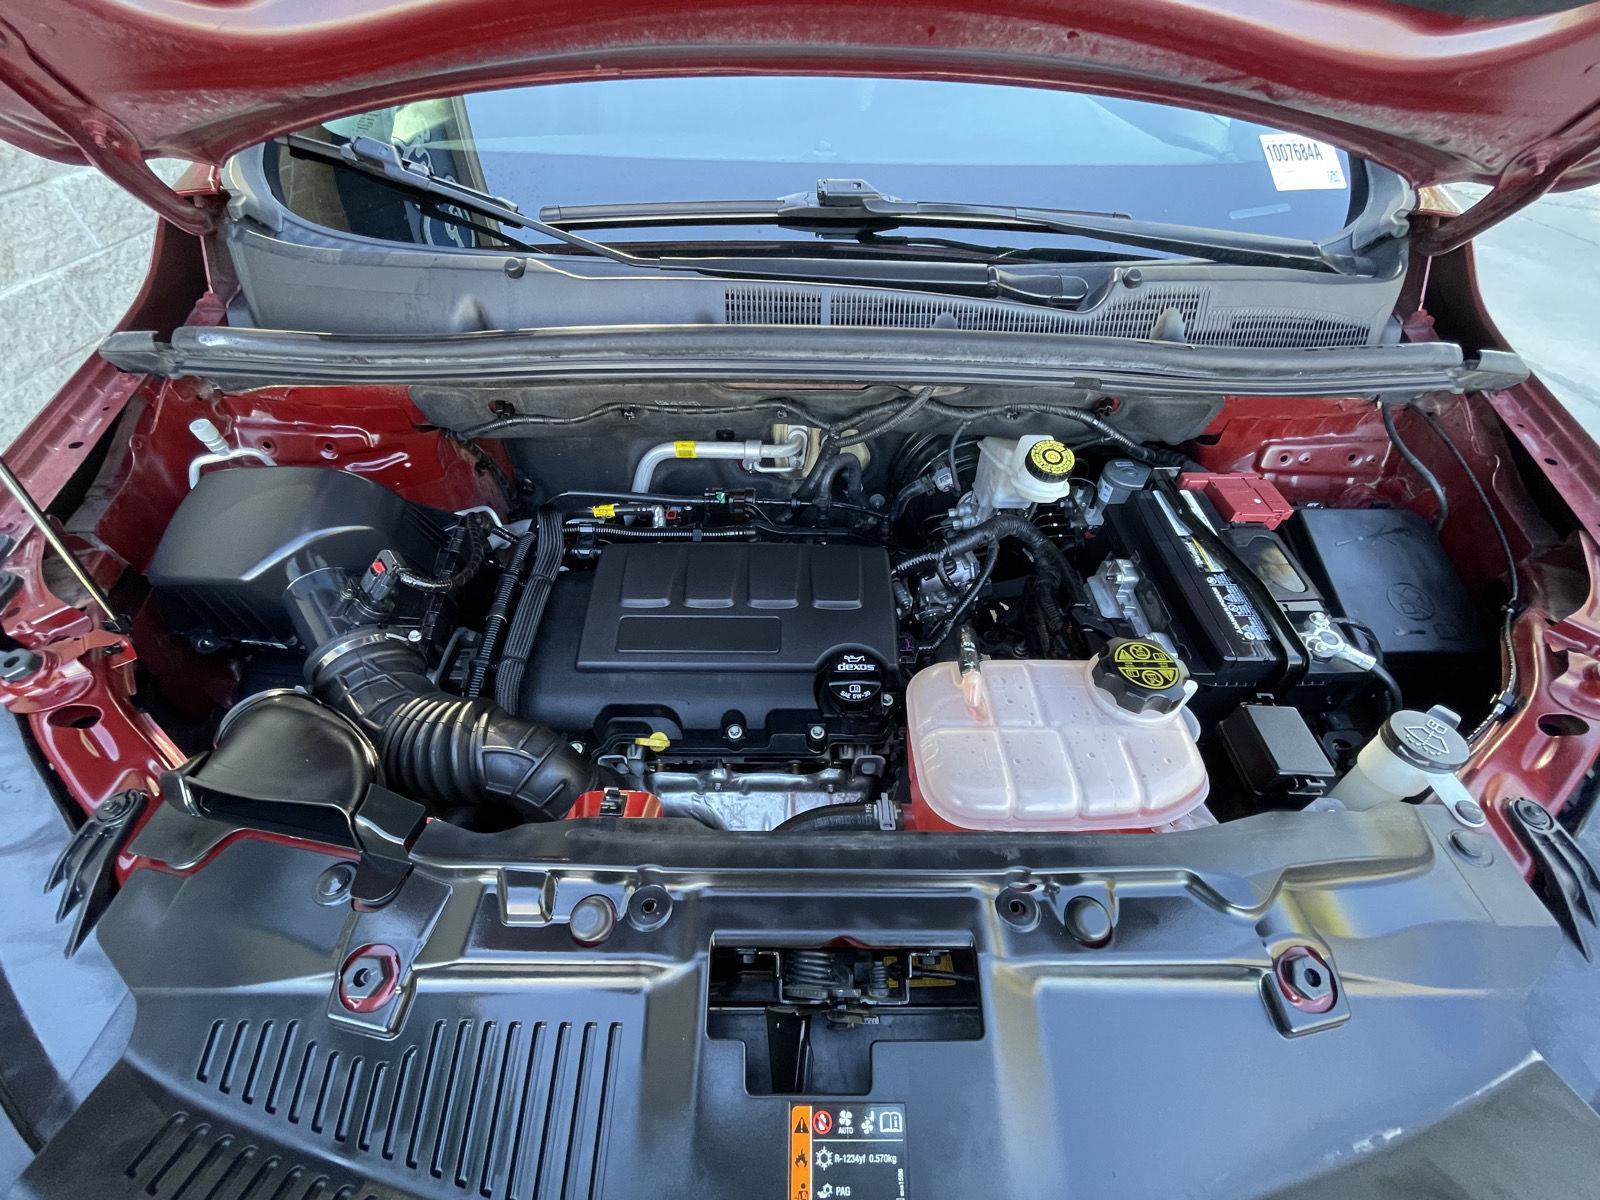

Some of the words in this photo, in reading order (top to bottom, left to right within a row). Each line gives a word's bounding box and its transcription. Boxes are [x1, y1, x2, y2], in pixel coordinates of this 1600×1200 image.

[1266, 143, 1324, 162] 1007684A
[837, 662, 876, 671] dexos
[838, 1126, 854, 1135] AUTO
[834, 1153, 866, 1165] R-1234yf
[869, 1153, 897, 1165] 0.570kg
[836, 1186, 851, 1196] PAG
